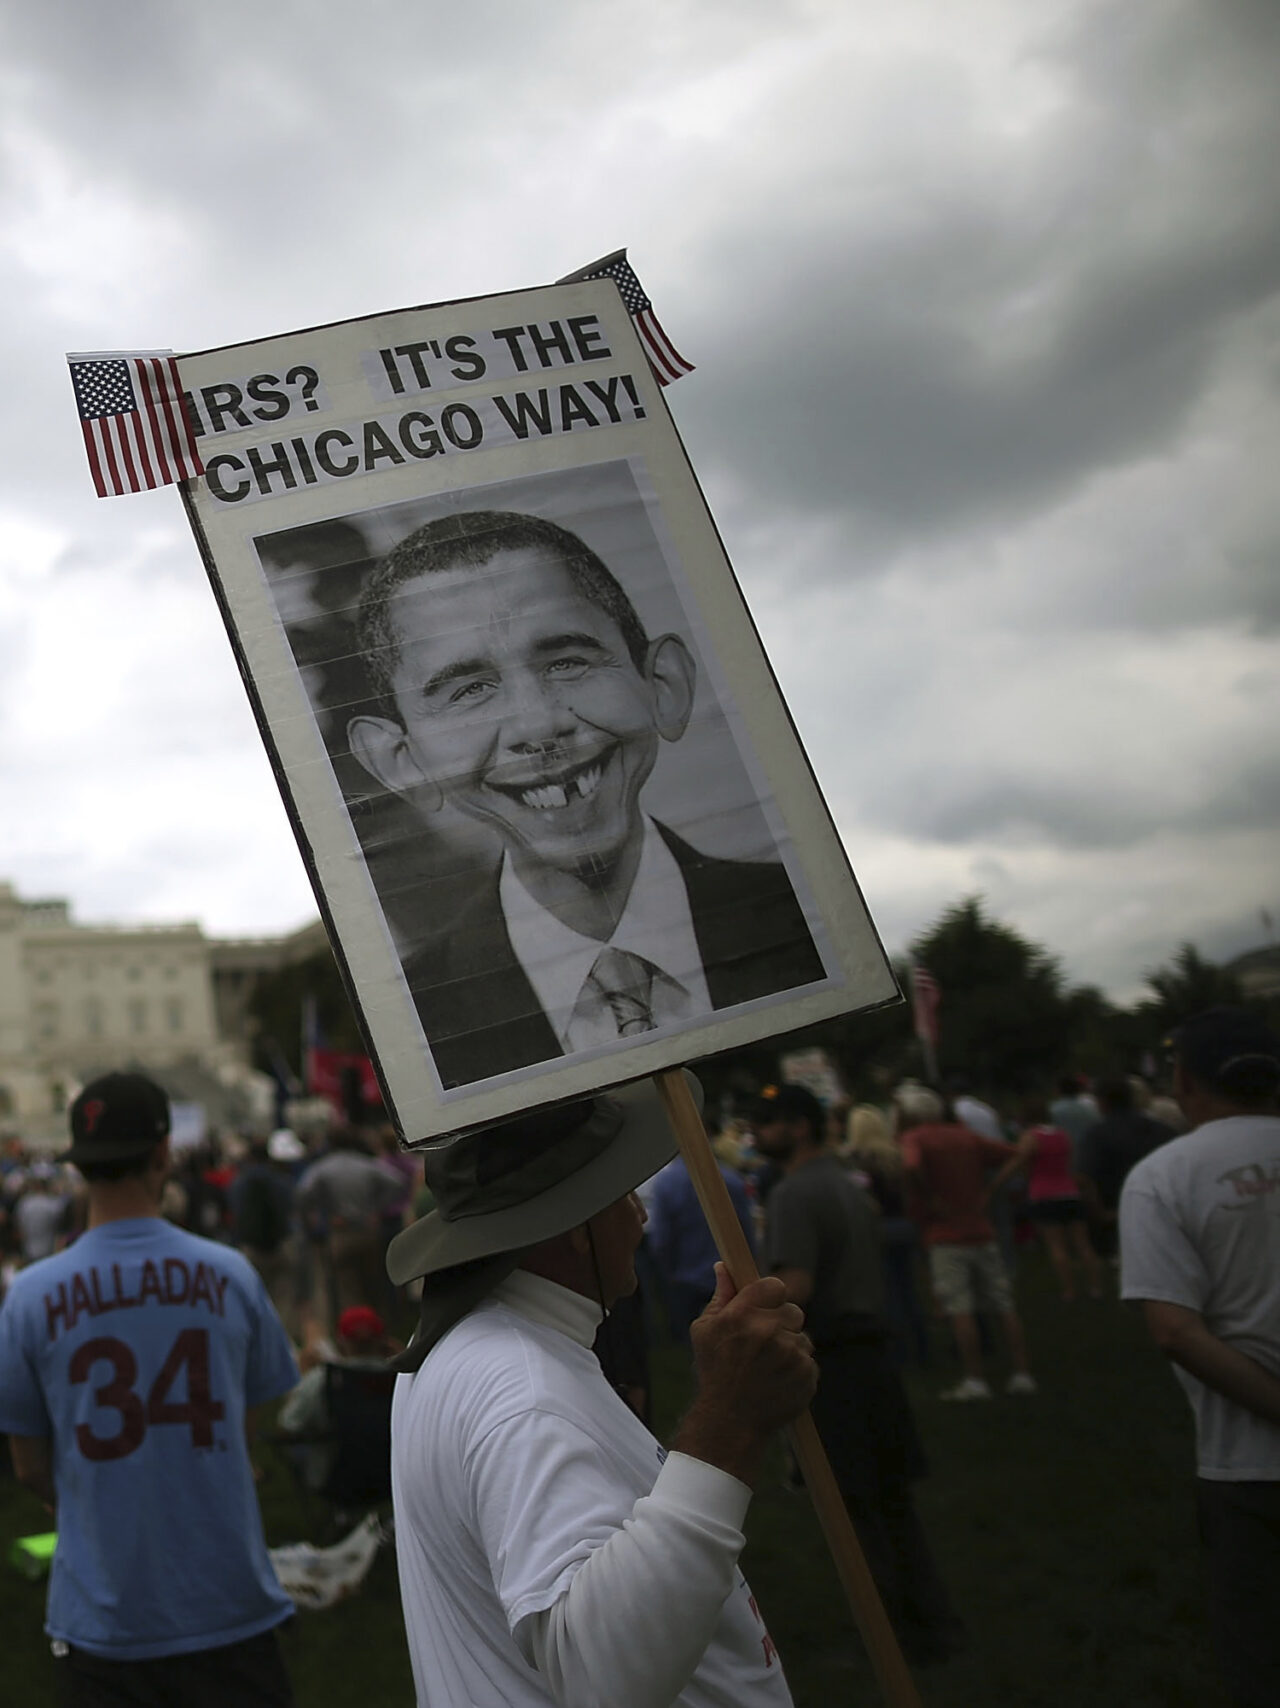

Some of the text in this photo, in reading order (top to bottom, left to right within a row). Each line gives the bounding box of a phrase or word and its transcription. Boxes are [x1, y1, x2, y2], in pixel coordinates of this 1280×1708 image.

[184, 314, 612, 438] IRS? IT'S THE
[205, 374, 647, 503] CHICAGO WAY!
[44, 1258, 228, 1342] HALLADAY
[69, 1327, 226, 1463] 34
